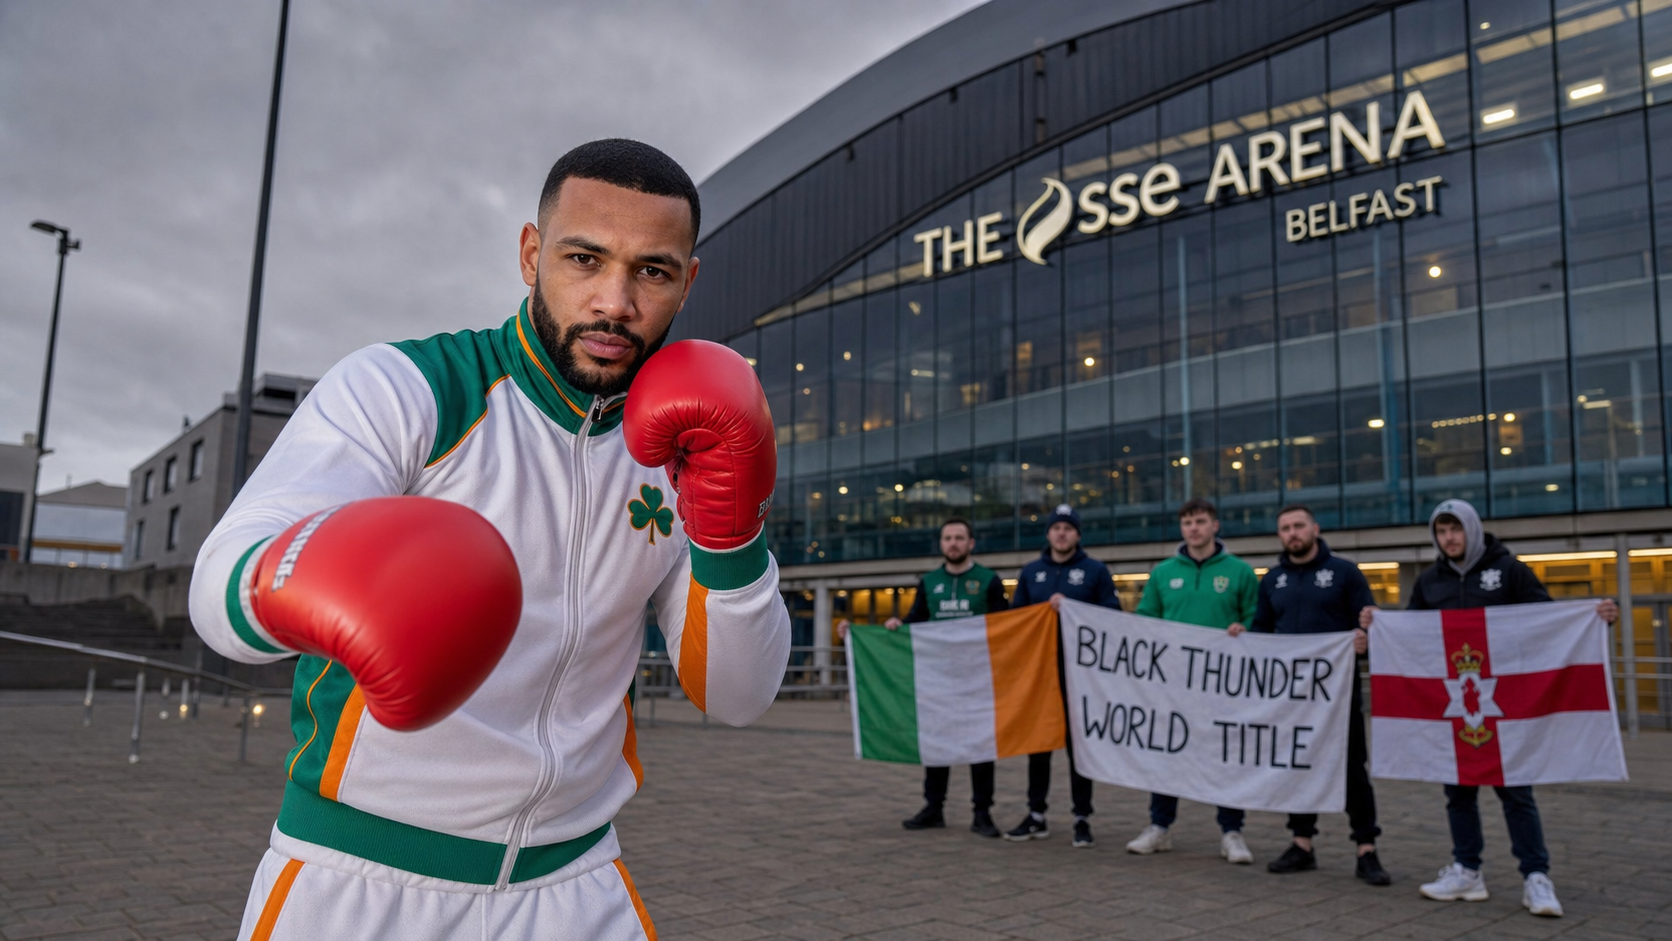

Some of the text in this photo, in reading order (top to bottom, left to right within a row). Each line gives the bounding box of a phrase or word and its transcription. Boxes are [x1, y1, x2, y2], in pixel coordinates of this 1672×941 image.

[914, 90, 1446, 277] THE sse ARENA
[1285, 175, 1444, 243] BELFAST
[1076, 625, 1334, 702] BLACK THUNDER
[1082, 695, 1315, 771] WORLD TITLE
